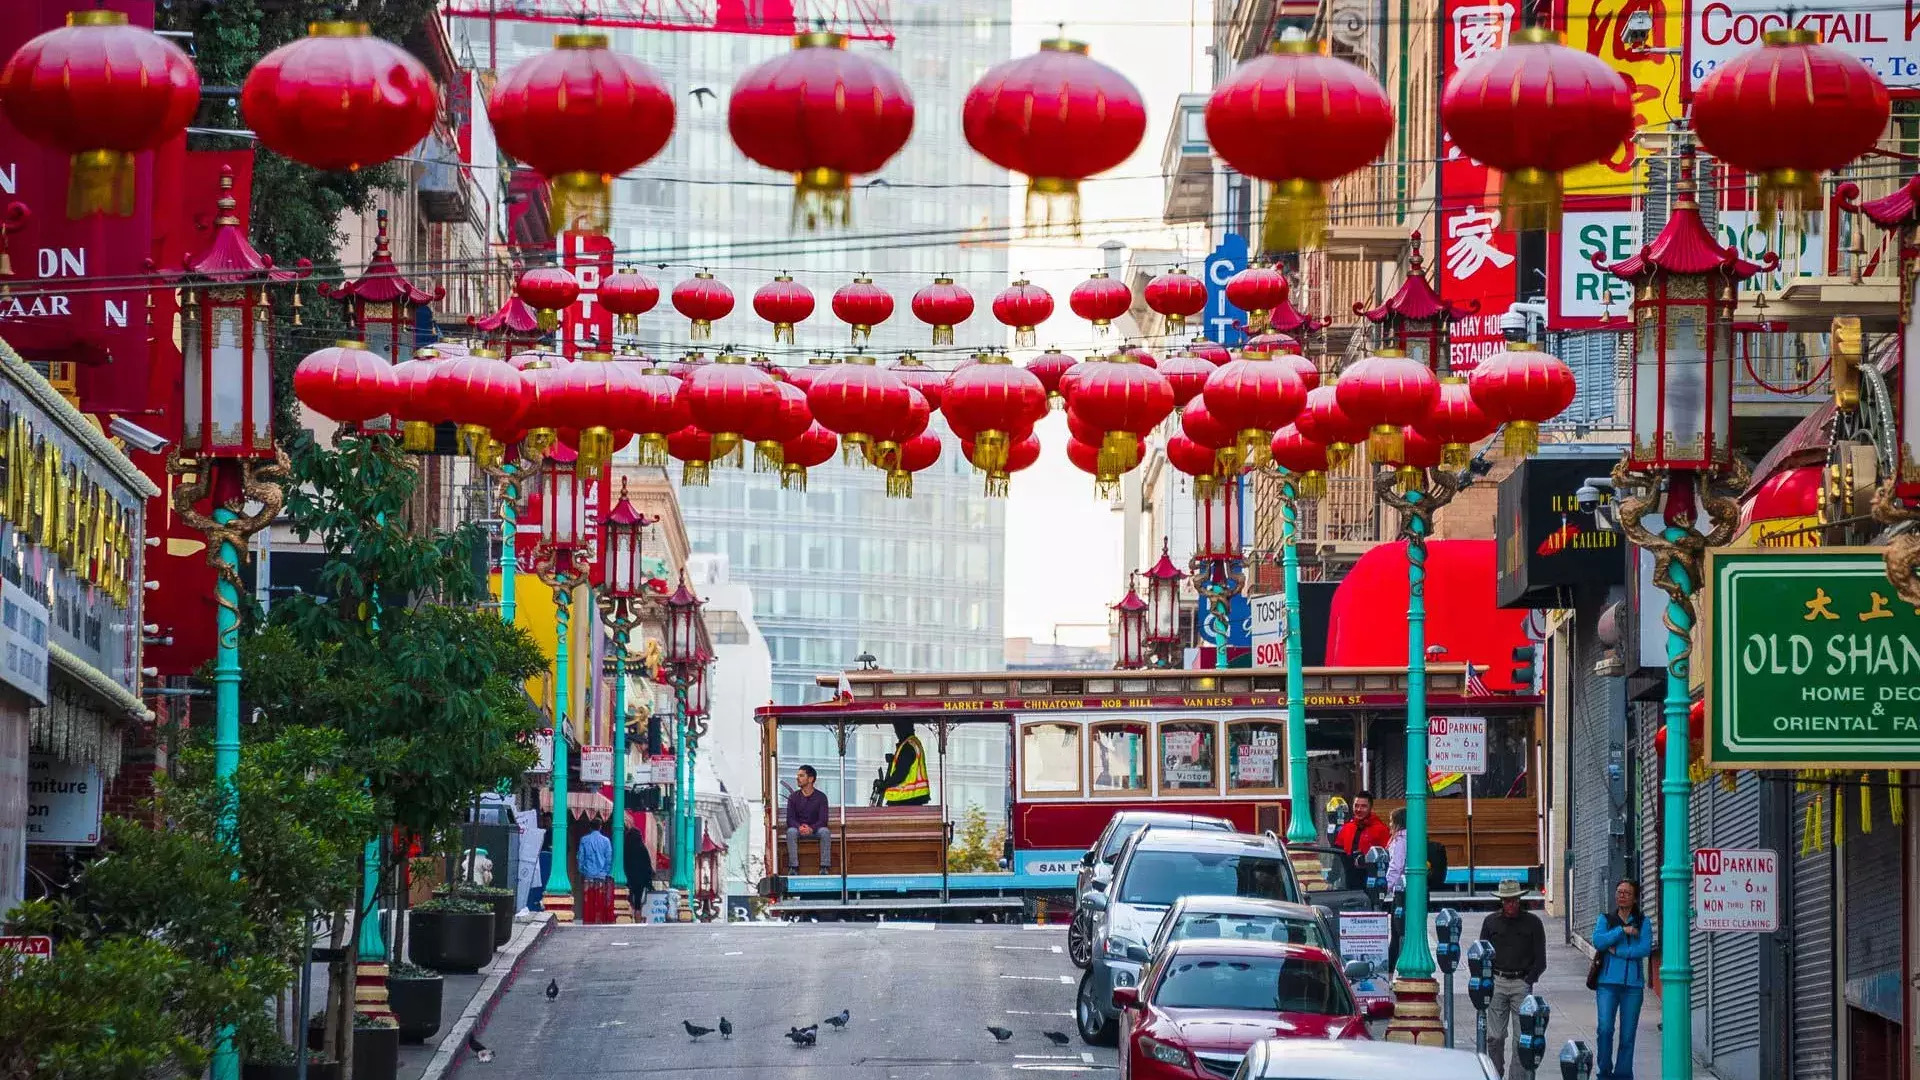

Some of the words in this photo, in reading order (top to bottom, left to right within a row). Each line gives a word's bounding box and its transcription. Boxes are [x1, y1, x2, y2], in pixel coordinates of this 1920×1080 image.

[0, 295, 72, 320] AAR
[1548, 531, 1567, 550] ART
[1573, 530, 1617, 549] GALLERY
[1743, 633, 1814, 676] OLD
[1802, 687, 1865, 701] HOME
[944, 701, 984, 711] MARKET
[1024, 700, 1084, 710] CHINATOWN
[1101, 699, 1122, 709] NOB
[1129, 699, 1153, 708] HILL
[1183, 698, 1203, 707] VAN
[1206, 698, 1233, 707] NESS
[1872, 702, 1885, 716] &
[1431, 718, 1447, 734] NO
[1449, 722, 1483, 734] PARKING
[1773, 716, 1879, 731] ORIENTAL
[1435, 736, 1442, 748] 2
[1463, 737, 1470, 748] 6
[1435, 751, 1449, 761] MON
[1467, 751, 1478, 761] FRI
[1039, 863, 1066, 873] SAN
[1697, 852, 1719, 873] NO
[1723, 857, 1773, 873] PARKING
[1703, 877, 1712, 893] 2
[1745, 879, 1754, 893] 6
[1703, 899, 1723, 912] MON
[1750, 900, 1766, 912] FRI
[1703, 919, 1731, 928] STREET
[1732, 918, 1771, 928] CLEANING
